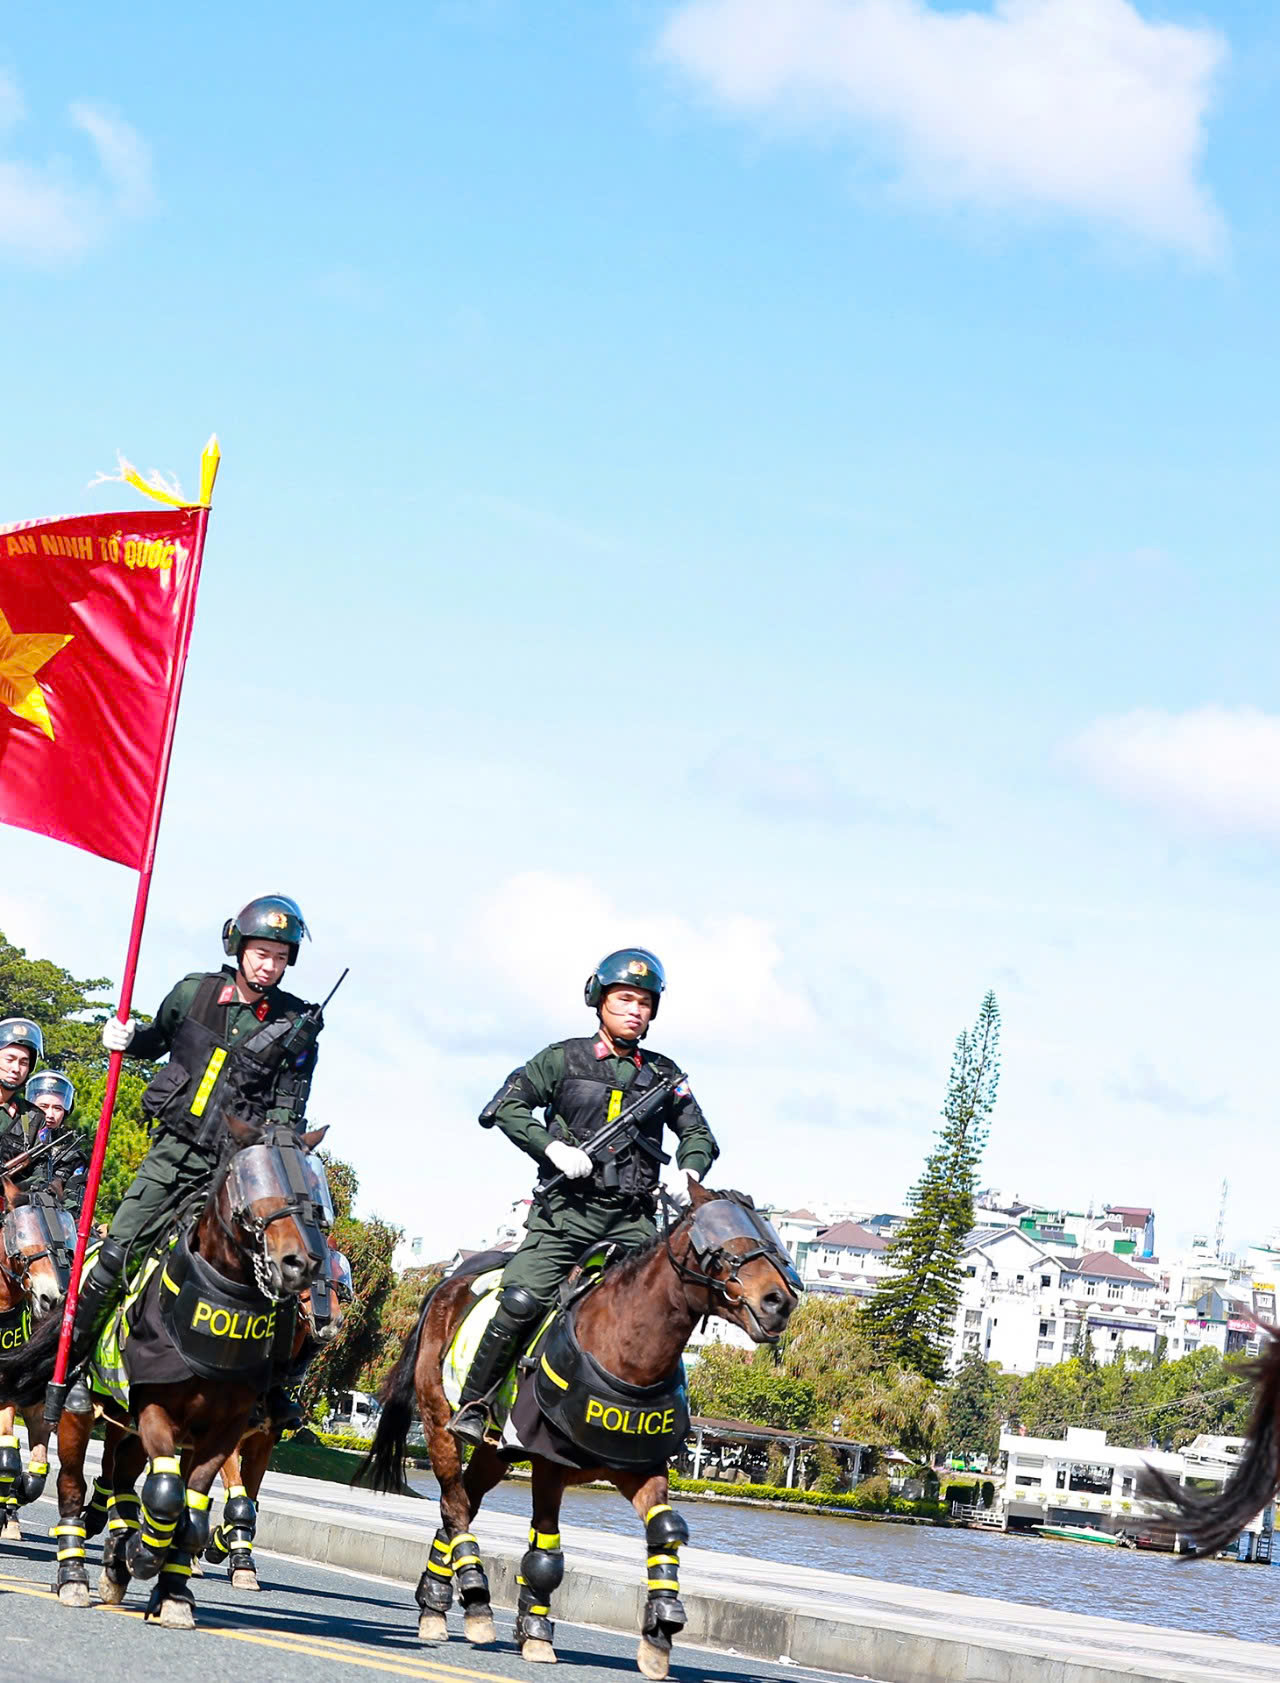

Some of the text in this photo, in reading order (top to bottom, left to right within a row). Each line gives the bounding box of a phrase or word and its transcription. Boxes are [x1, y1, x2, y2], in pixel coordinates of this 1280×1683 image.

[7, 535, 37, 556] AN
[40, 534, 93, 560] NINH
[191, 1301, 277, 1340] POLICE
[585, 1399, 675, 1435] POLICE
